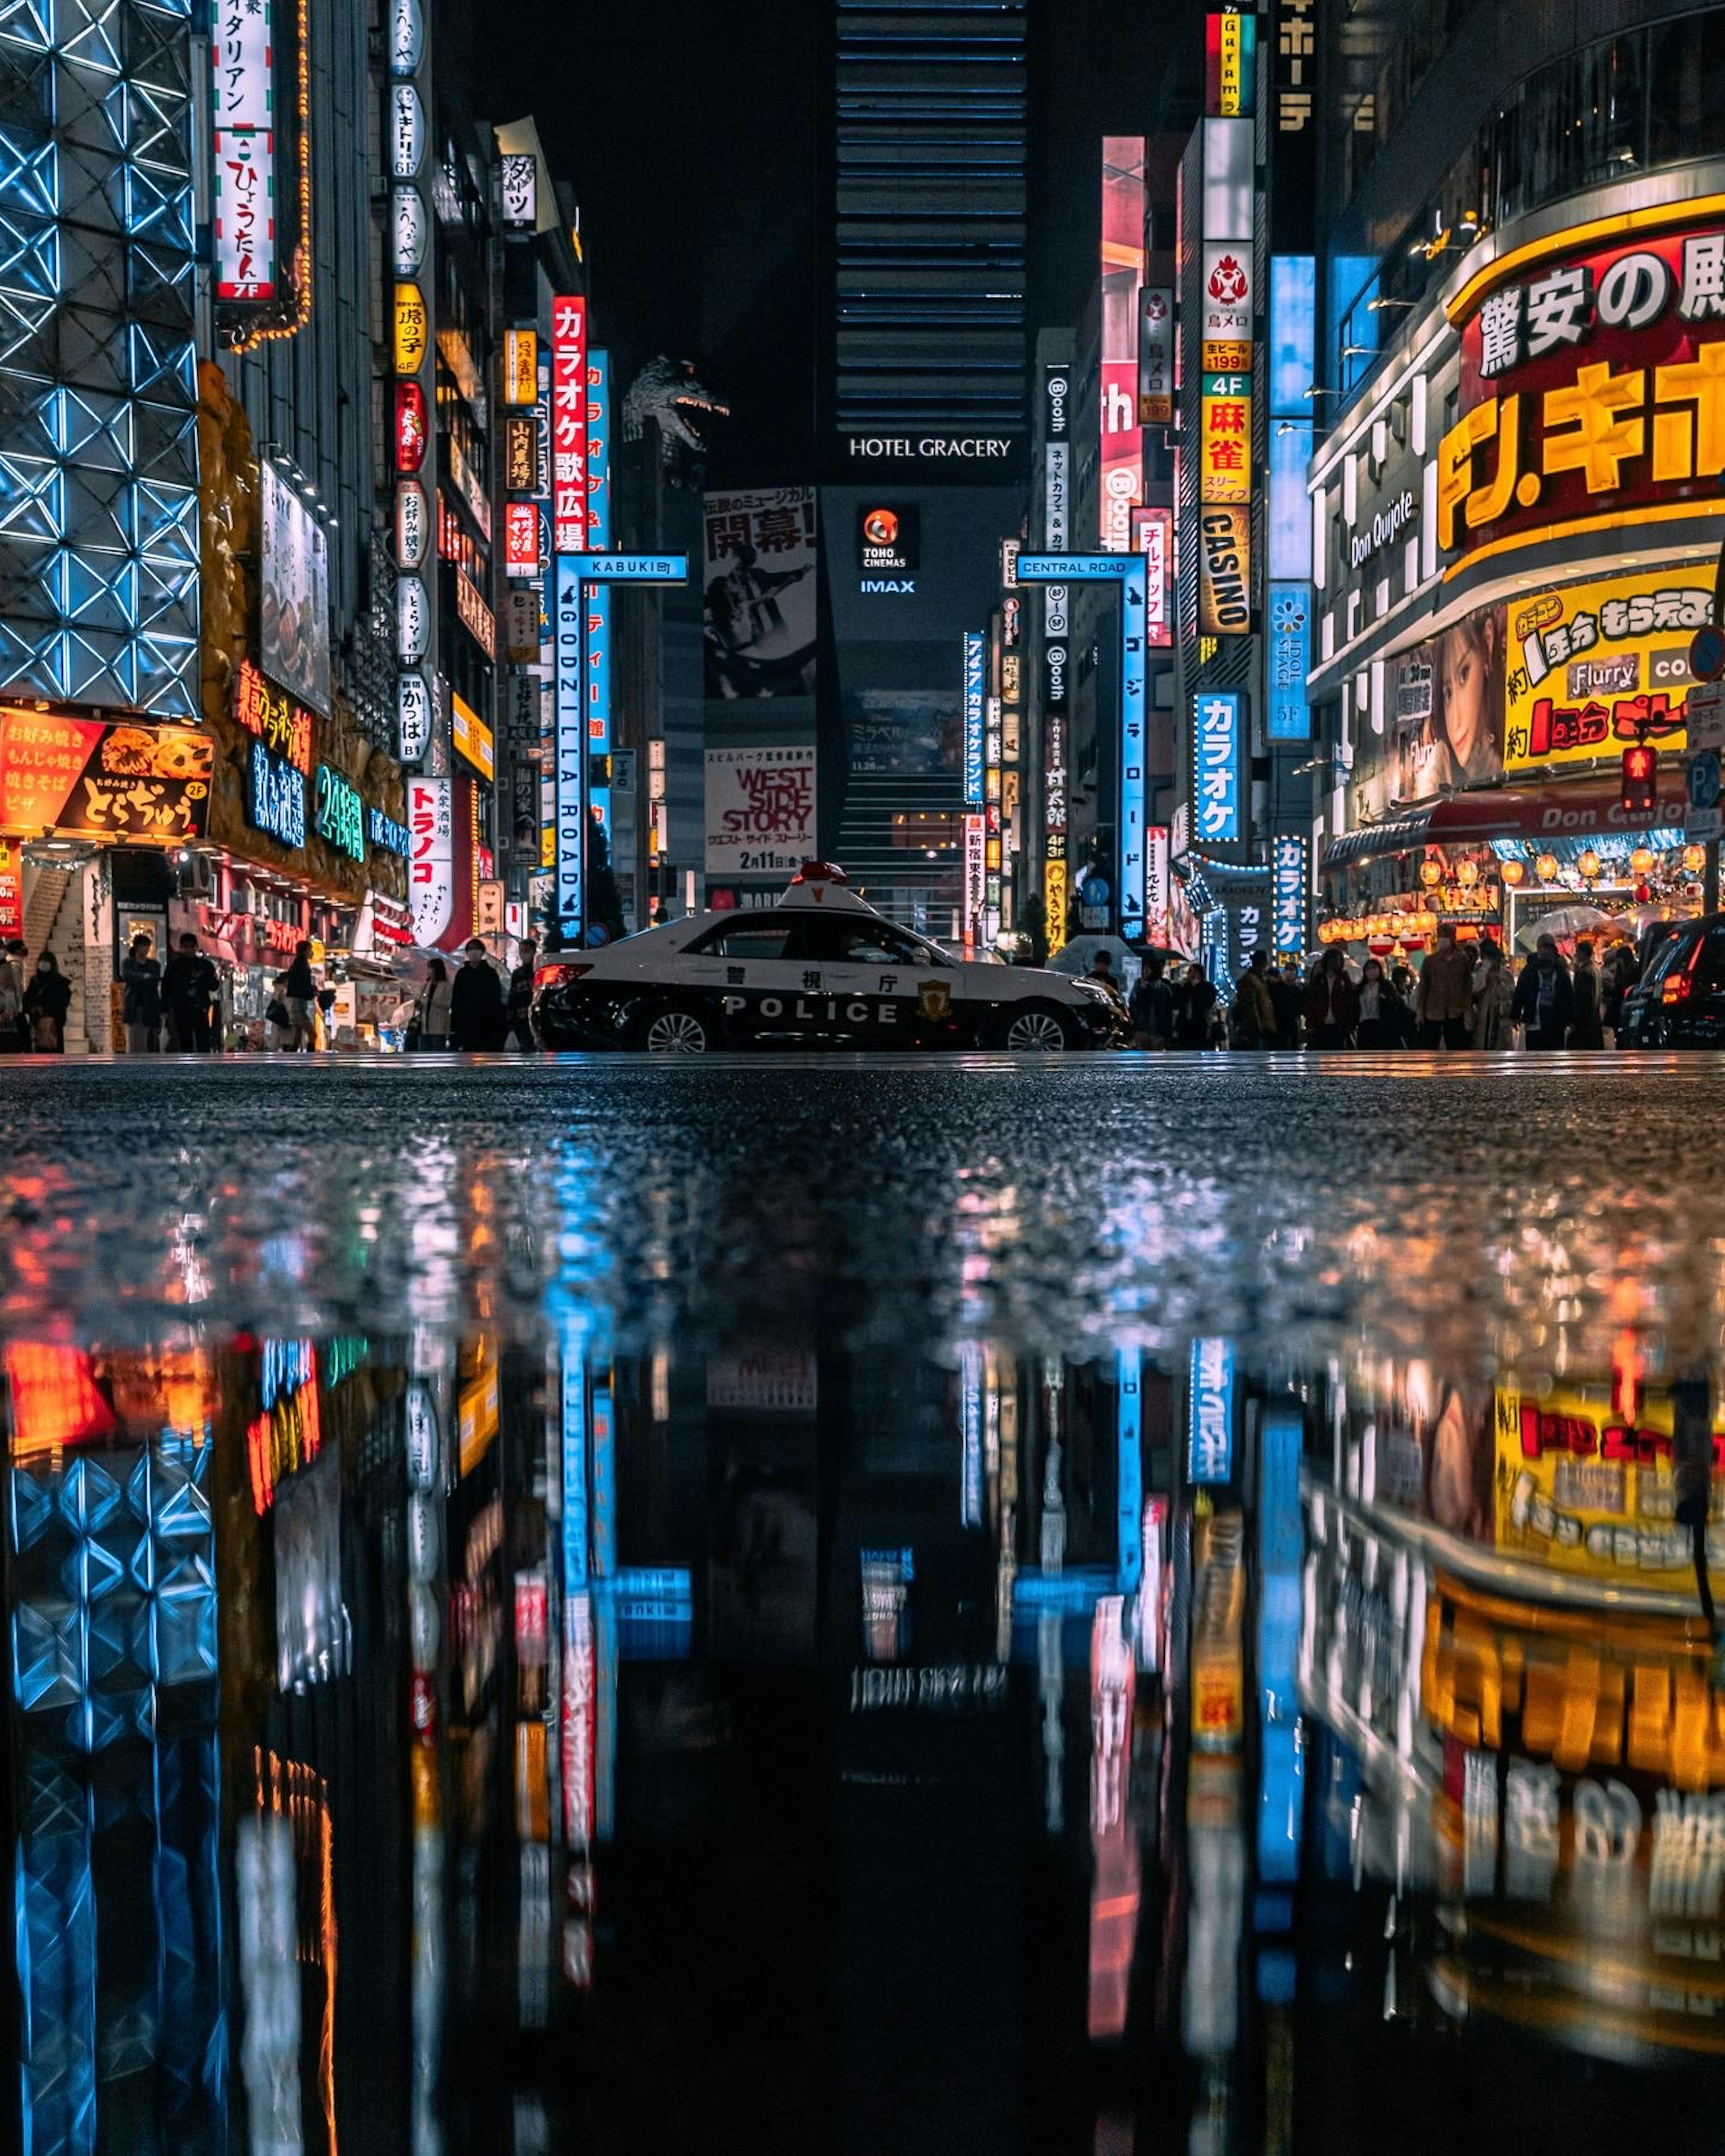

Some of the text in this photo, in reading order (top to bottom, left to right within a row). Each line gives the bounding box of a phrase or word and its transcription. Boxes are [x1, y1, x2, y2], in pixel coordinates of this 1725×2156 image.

[1280, 0, 1314, 131] ホーテ
[509, 161, 534, 213] ダーツ
[226, 161, 257, 281] ひょうたん
[233, 283, 258, 297] 7F
[399, 309, 422, 354] 虎の子
[1208, 314, 1248, 328] 鳥メロ
[1208, 344, 1247, 354] 生ビール
[1212, 377, 1243, 395] 4F
[1048, 378, 1068, 433] Booth
[555, 308, 584, 551] カラオケ歌広場
[1209, 403, 1245, 471] 麻雀
[850, 440, 1011, 457] HOTEL GRACERY
[1051, 450, 1063, 512] ネットカフェ
[1204, 476, 1237, 486] スリー
[1351, 490, 1413, 569] Don Quijote
[863, 548, 894, 558] TOHO
[863, 558, 907, 568] CINEMAS
[593, 561, 671, 574] KABUKI町
[1023, 563, 1125, 572] CENTRAL ROAD
[1203, 513, 1247, 626] CASINO
[861, 580, 915, 593] IMAX
[403, 655, 419, 665] 1F
[1047, 646, 1067, 700] Booth
[1290, 639, 1301, 681] IDOL
[402, 689, 422, 740] かっぱ
[968, 640, 982, 796] 747 カラオケランド
[1277, 705, 1300, 721] 5F
[8, 725, 84, 748] お好み焼き
[561, 611, 578, 884] GODZILLA ROAD
[8, 748, 84, 771] もんじゃ焼き
[405, 746, 420, 755] B1
[1126, 636, 1143, 866] ゴジラロード
[736, 767, 813, 791] WEST
[1203, 700, 1234, 834] カラオケ
[6, 770, 68, 791] 焼きそば
[189, 786, 204, 795] 2F
[84, 776, 192, 829] とらぢゅう
[437, 781, 450, 838] 大衆酒場
[748, 787, 813, 811] SIDE
[1045, 768, 1067, 828] 甘太郎
[722, 805, 813, 832] STORY
[1542, 808, 1597, 828] Don
[412, 787, 435, 883] トラノコ
[1047, 835, 1065, 846] 4F
[1047, 847, 1065, 857] 3F
[1278, 843, 1301, 946] カラオケ
[1277, 952, 1300, 968] B1
[726, 966, 898, 992] 警視庁
[725, 995, 898, 1023] POLICE
